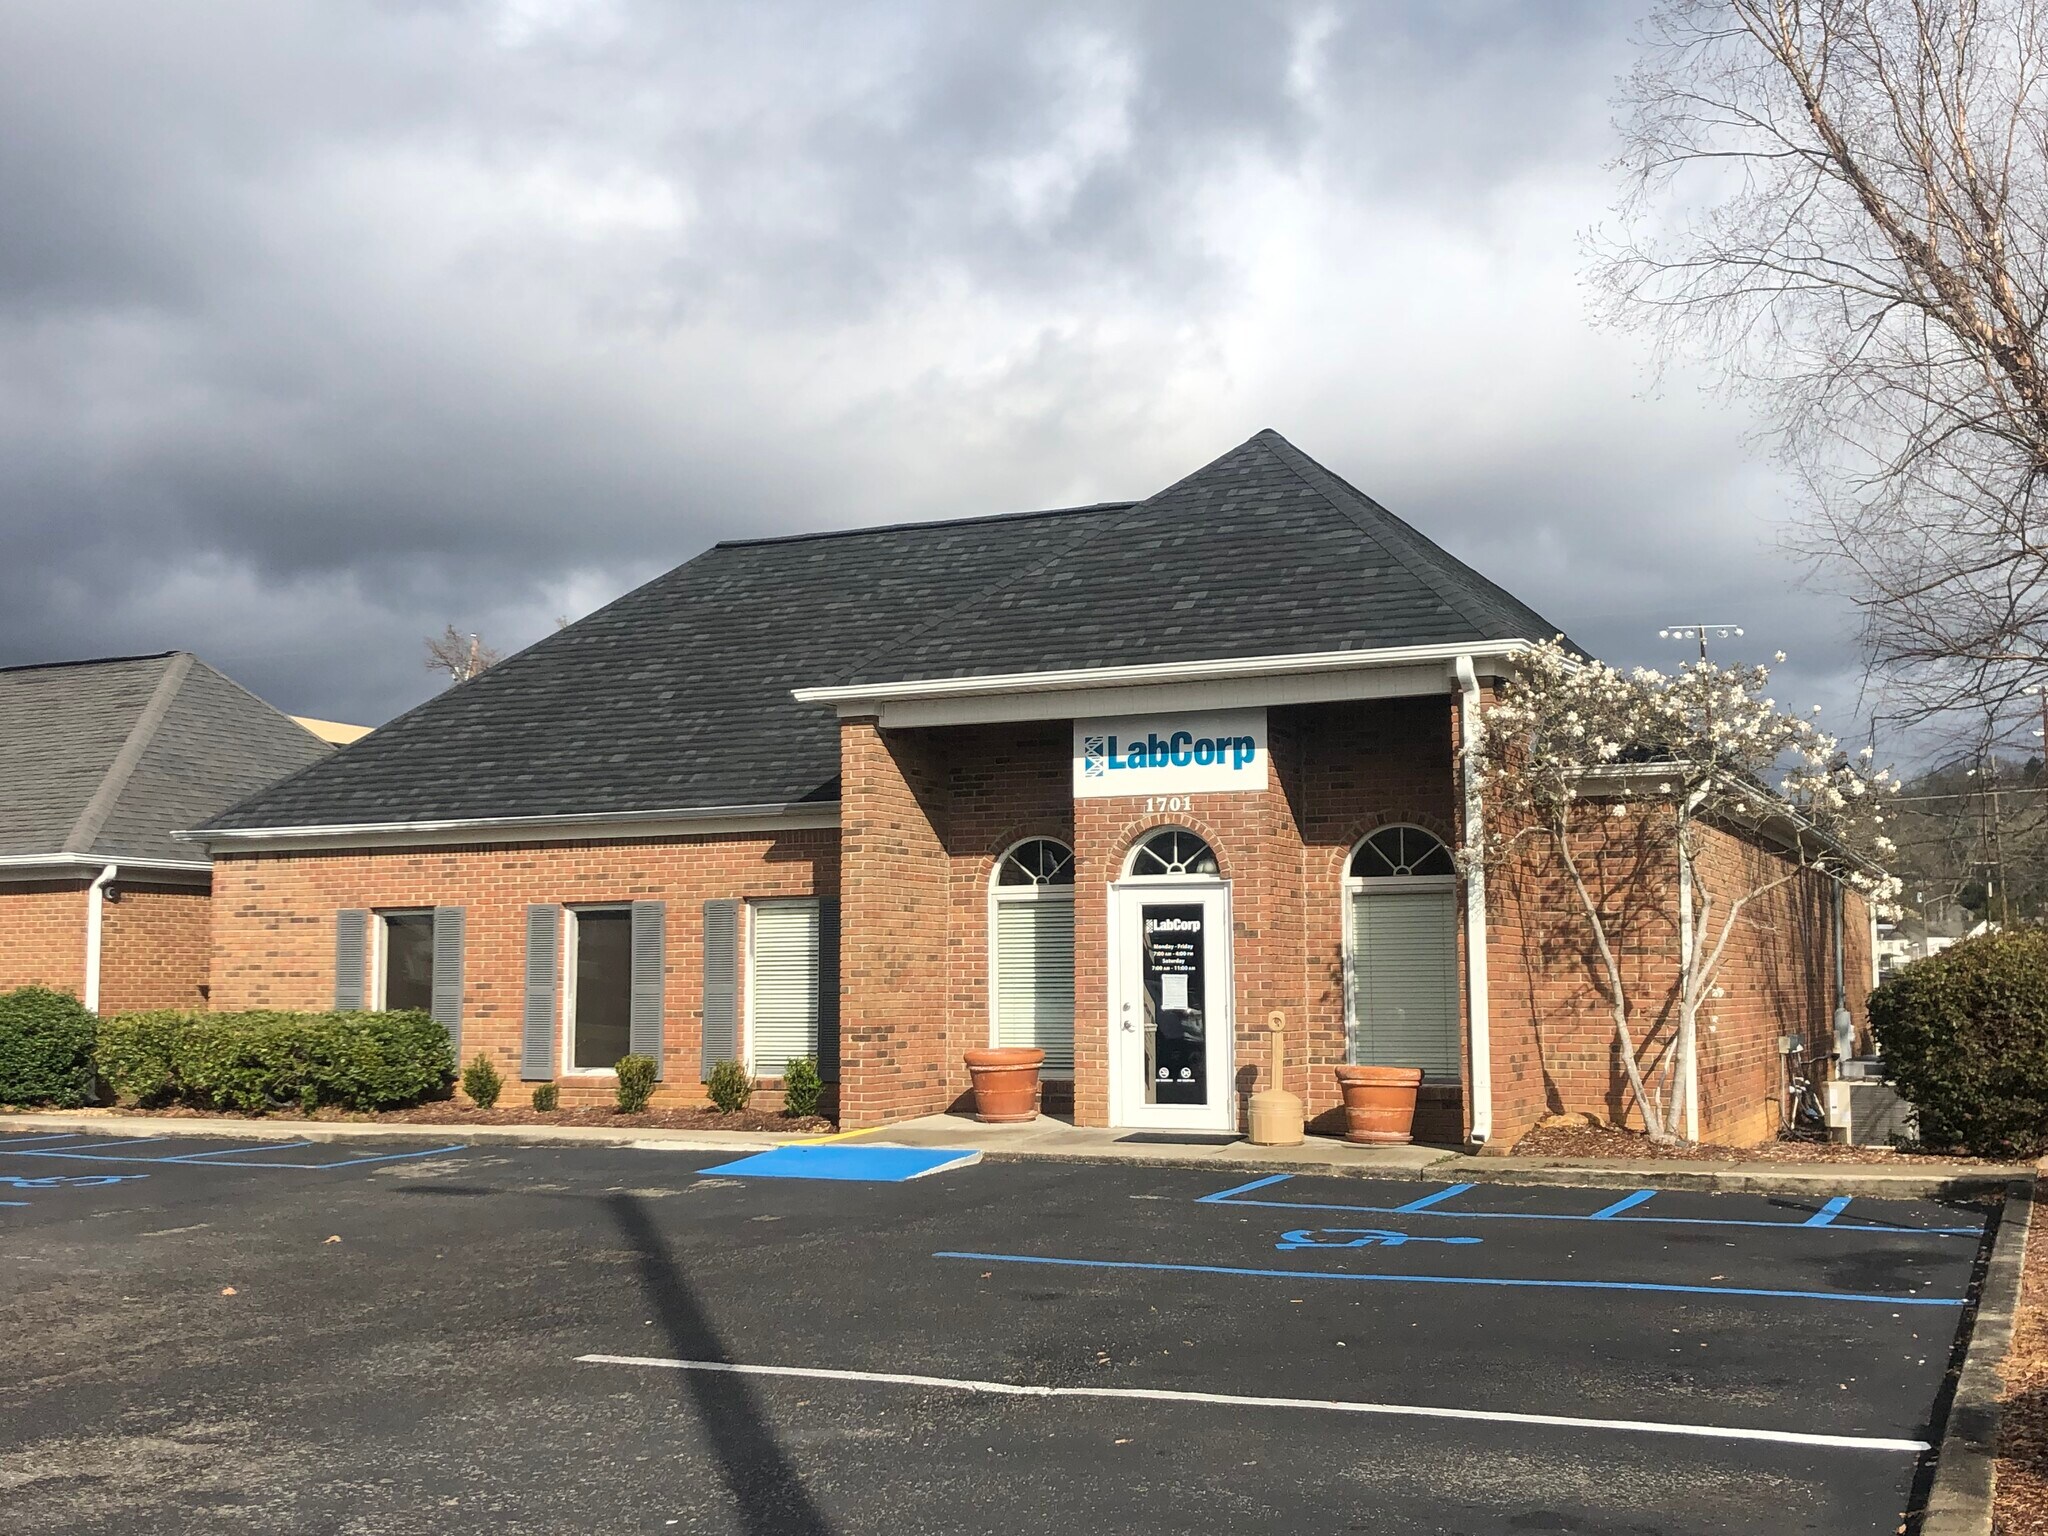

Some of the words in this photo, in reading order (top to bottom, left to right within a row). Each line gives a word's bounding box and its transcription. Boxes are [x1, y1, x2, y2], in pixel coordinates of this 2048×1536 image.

[1108, 731, 1256, 770] LabCorp
[1146, 796, 1192, 812] 1701
[1154, 918, 1200, 932] LabCorp
